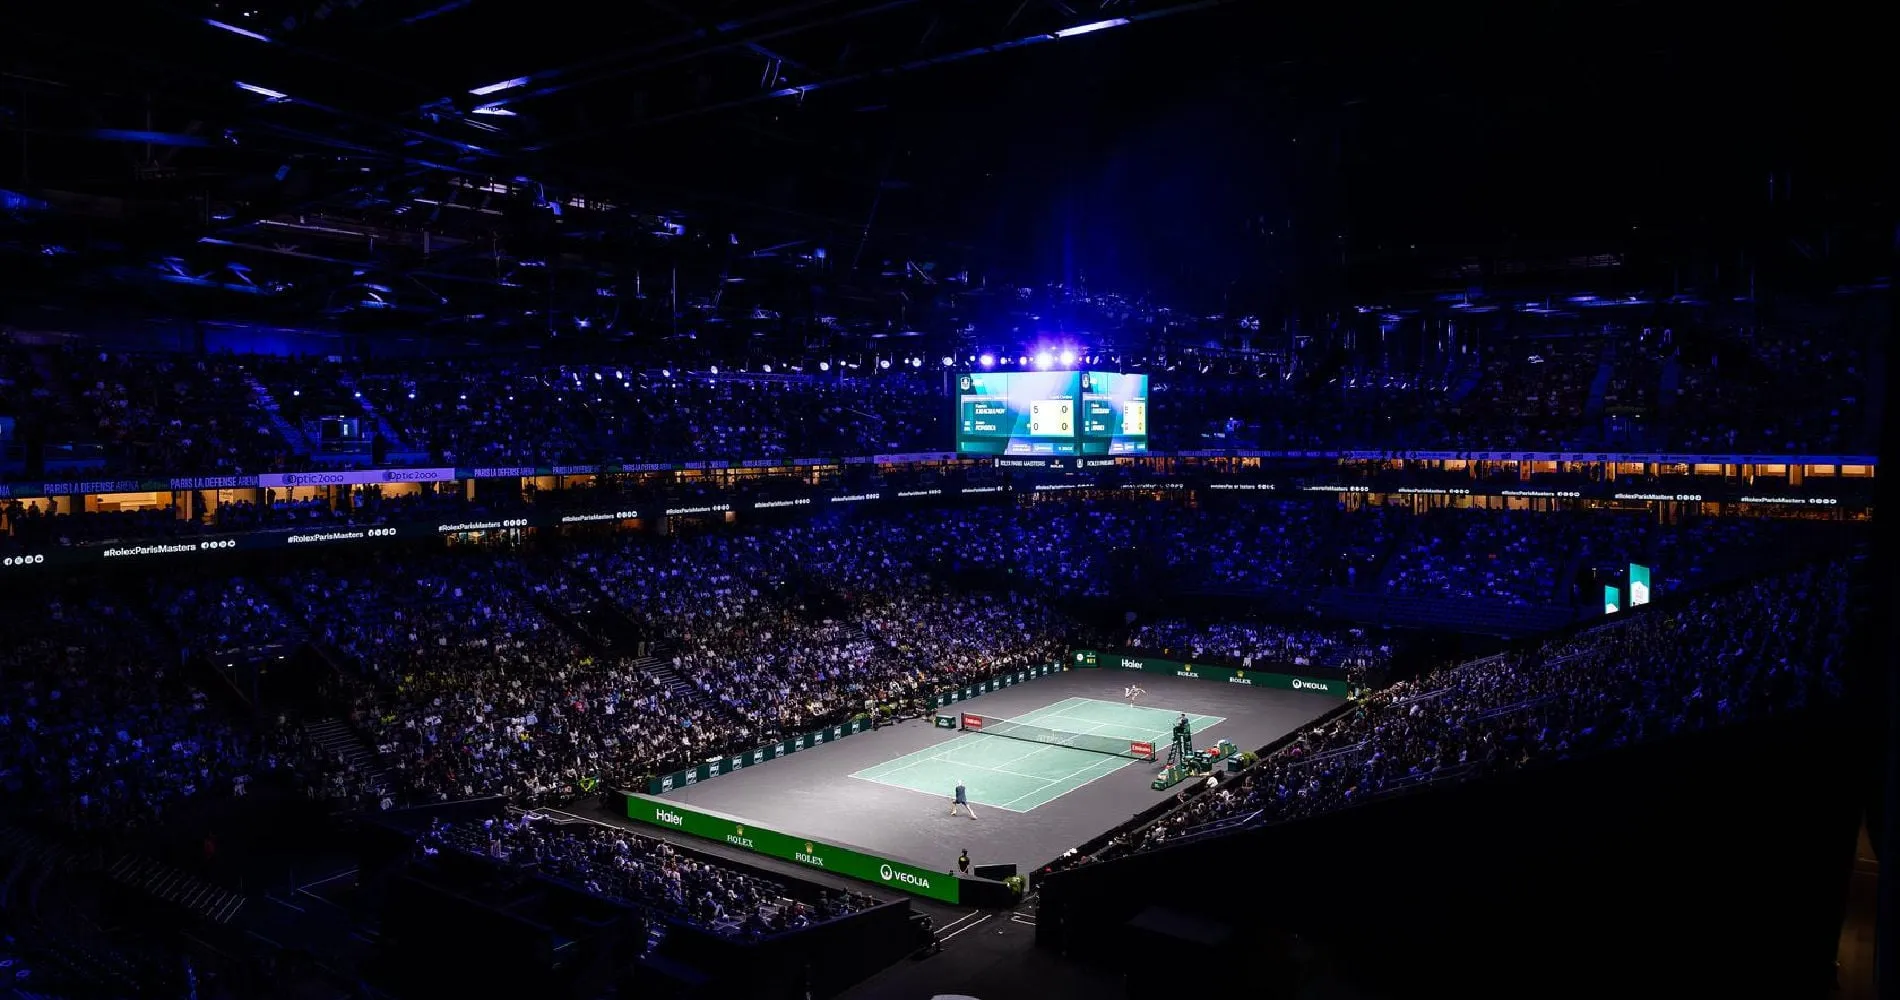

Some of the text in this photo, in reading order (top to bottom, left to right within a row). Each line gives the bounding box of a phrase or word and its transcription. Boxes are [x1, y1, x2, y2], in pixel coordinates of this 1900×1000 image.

[1033, 405, 1039, 415] 5
[1033, 422, 1039, 432] 0
[44, 483, 68, 494] PARIS
[80, 481, 115, 493] DEFENSE
[170, 478, 192, 488] PARIS
[205, 476, 236, 487] DEFENSE
[238, 475, 259, 486] ARENA
[439, 521, 500, 532] #RolexParisMasters
[288, 532, 363, 543] #RolexParisMasters
[104, 545, 196, 556] #RolexParisMasters
[1121, 658, 1143, 669] Haier
[656, 808, 683, 826] Haier
[726, 834, 753, 848] ROLEX
[795, 852, 824, 867] ROLEX
[894, 870, 930, 889] VEOLIA
